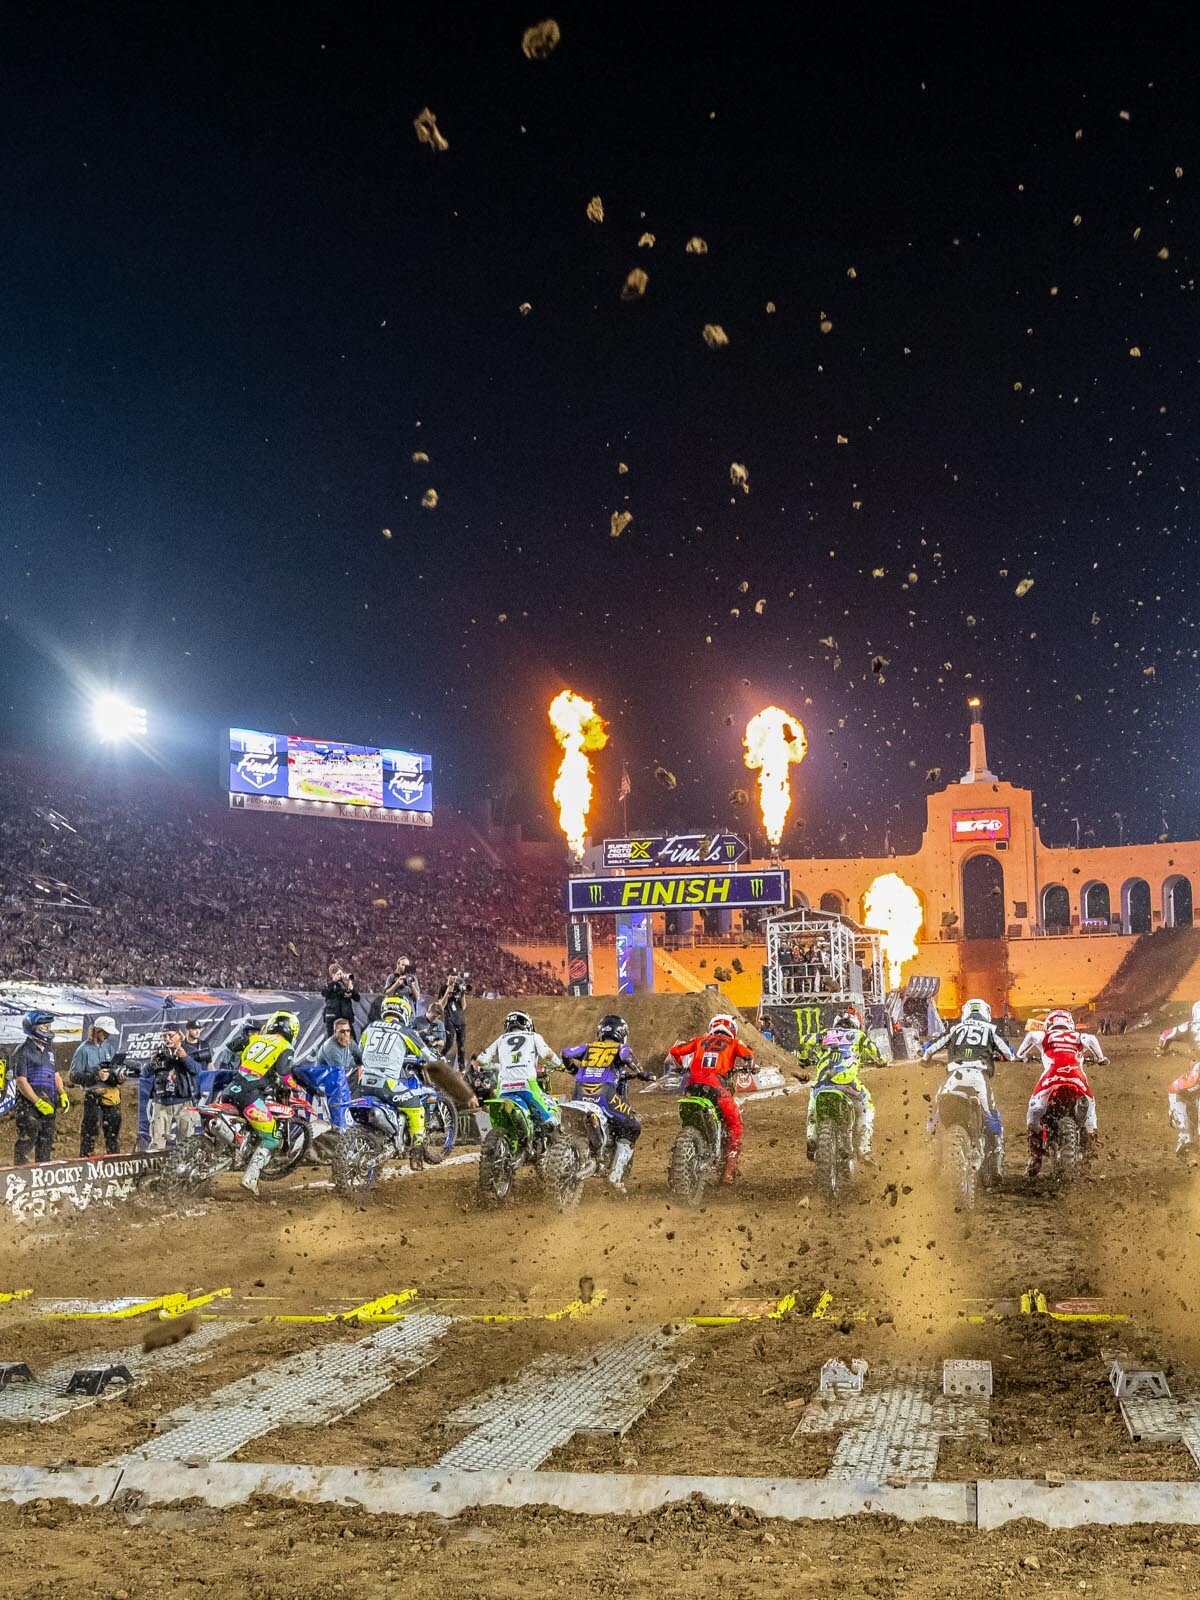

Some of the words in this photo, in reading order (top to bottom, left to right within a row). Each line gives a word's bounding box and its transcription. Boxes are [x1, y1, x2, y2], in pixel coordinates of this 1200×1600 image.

[338, 807, 361, 818] Keck
[362, 810, 400, 823] Medicine
[401, 813, 410, 823] of
[412, 814, 431, 825] USC
[621, 878, 731, 906] FINISH
[127, 1032, 164, 1042] SUPE
[367, 1030, 399, 1055] 511
[507, 1035, 526, 1052] 9
[955, 1026, 989, 1047] 751
[1048, 1030, 1081, 1044] 23
[246, 1041, 277, 1064] 91
[581, 1047, 618, 1068] 36
[31, 1166, 83, 1188] ROCKY
[87, 1156, 164, 1180] MOUNTAIN
